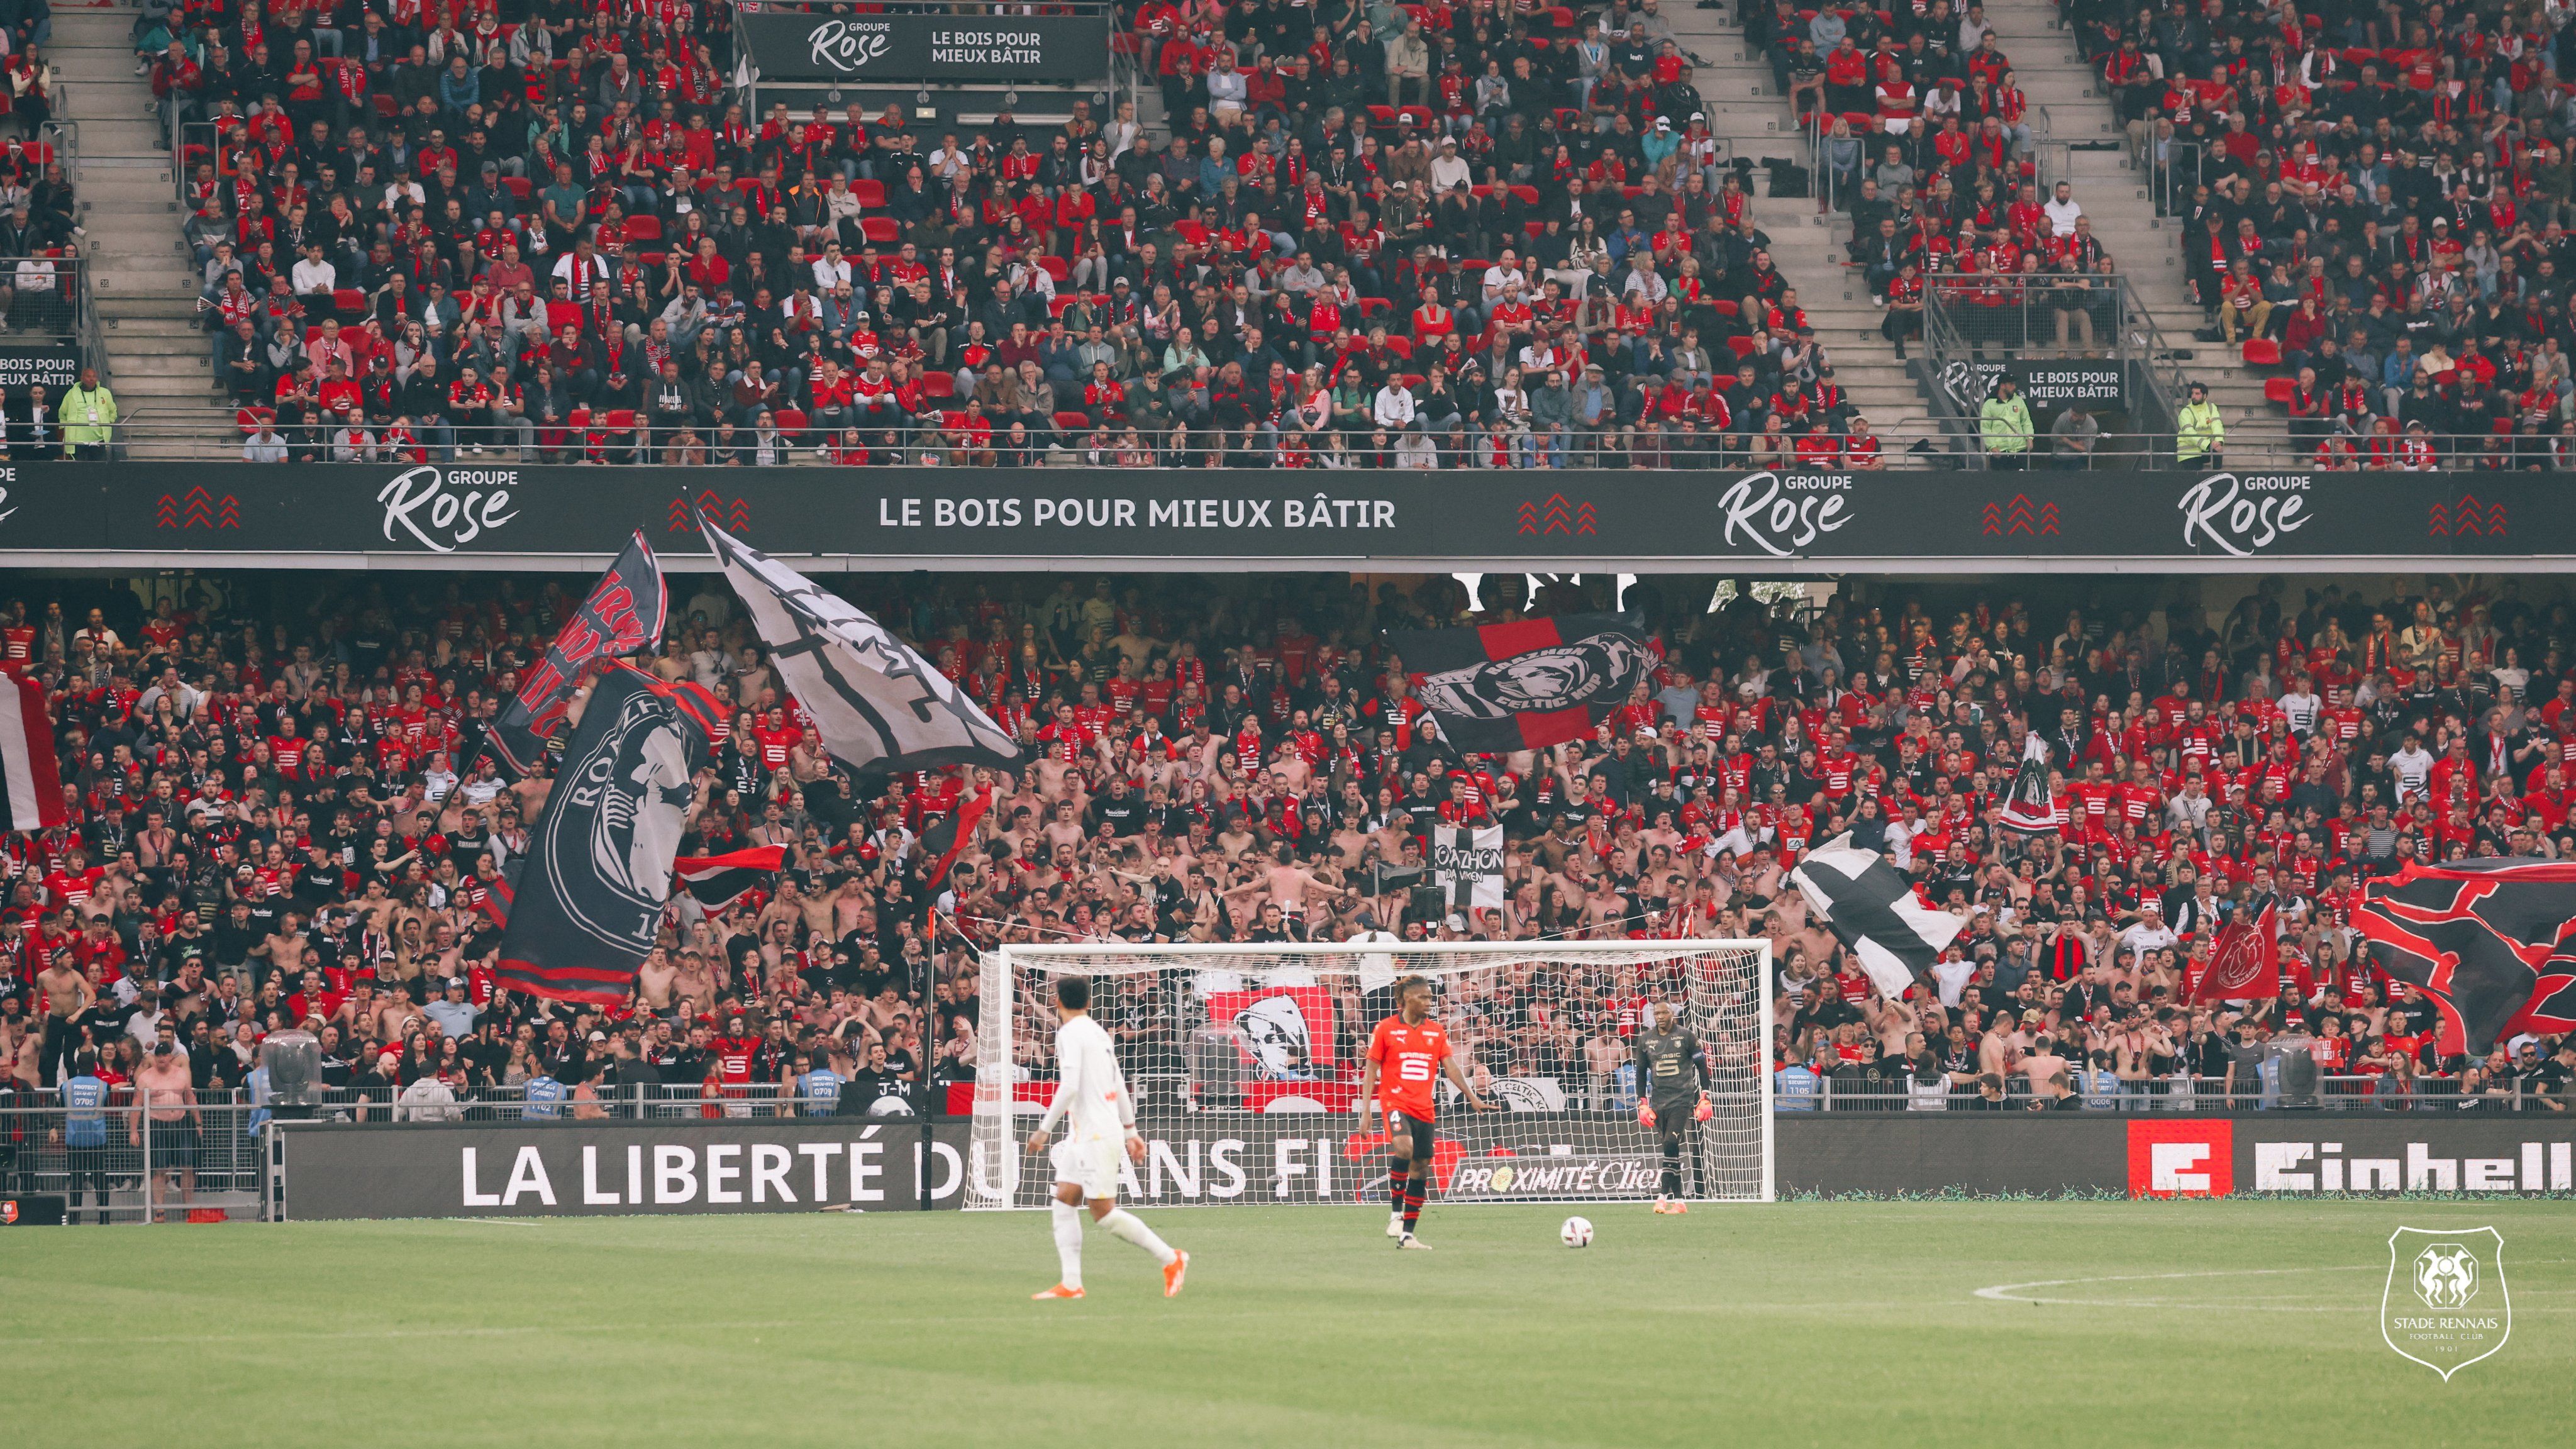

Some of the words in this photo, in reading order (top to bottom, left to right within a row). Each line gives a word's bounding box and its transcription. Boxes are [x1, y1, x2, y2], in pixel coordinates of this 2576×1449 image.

[849, 23, 891, 31] GROUPE
[808, 19, 892, 71] Rose
[933, 31, 950, 45] LE
[955, 31, 992, 45] BOIS
[997, 33, 1041, 46] POUR
[933, 49, 987, 62] MIEUX
[992, 48, 1041, 64] BÂTIR
[91, 242, 99, 250] 36
[101, 279, 108, 287] 35
[182, 279, 191, 287] 35
[109, 319, 117, 328] 34
[190, 320, 198, 328] 34
[0, 358, 33, 370] BOIS
[36, 358, 75, 370] POUR
[1970, 364, 2006, 372] ROUPE
[0, 373, 28, 385] EUX
[32, 371, 75, 386] BÂTIR
[2029, 372, 2045, 383] LE
[2048, 372, 2079, 384] BOIS
[2082, 372, 2118, 383] POUR
[2029, 386, 2074, 397] MIEUX
[2077, 384, 2118, 397] BÂTIR
[448, 470, 518, 485] GROUPE
[1785, 475, 1852, 489] GROUPE
[2245, 476, 2311, 491] GROUPE
[377, 465, 520, 552] Rose
[880, 499, 921, 526] LE
[935, 498, 1022, 527] BOIS
[1035, 499, 1136, 527] POUR
[1149, 499, 1272, 528] MIEUX
[1284, 493, 1396, 528] BÂTIR
[1718, 472, 1855, 556] Rose
[2178, 473, 2314, 556] Rose
[1485, 646, 1589, 676] ROAZHON
[1495, 695, 1568, 709] CELTIC
[1570, 673, 1601, 700] KOP
[1445, 870, 1457, 881] DA
[1459, 871, 1484, 882] VIKEN
[1399, 1052, 1433, 1060] SAMSIC
[814, 1088, 832, 1097] 0709
[1505, 1082, 1536, 1101] CELTIC
[1790, 1085, 1809, 1095] 1105
[74, 1097, 95, 1107] 0705
[1389, 1109, 1401, 1122] 4
[462, 1146, 557, 1206] LA
[582, 1125, 884, 1205] LIBERTÉ
[2255, 1142, 2572, 1191] Einhell
[1598, 1161, 1667, 1191] Clie
